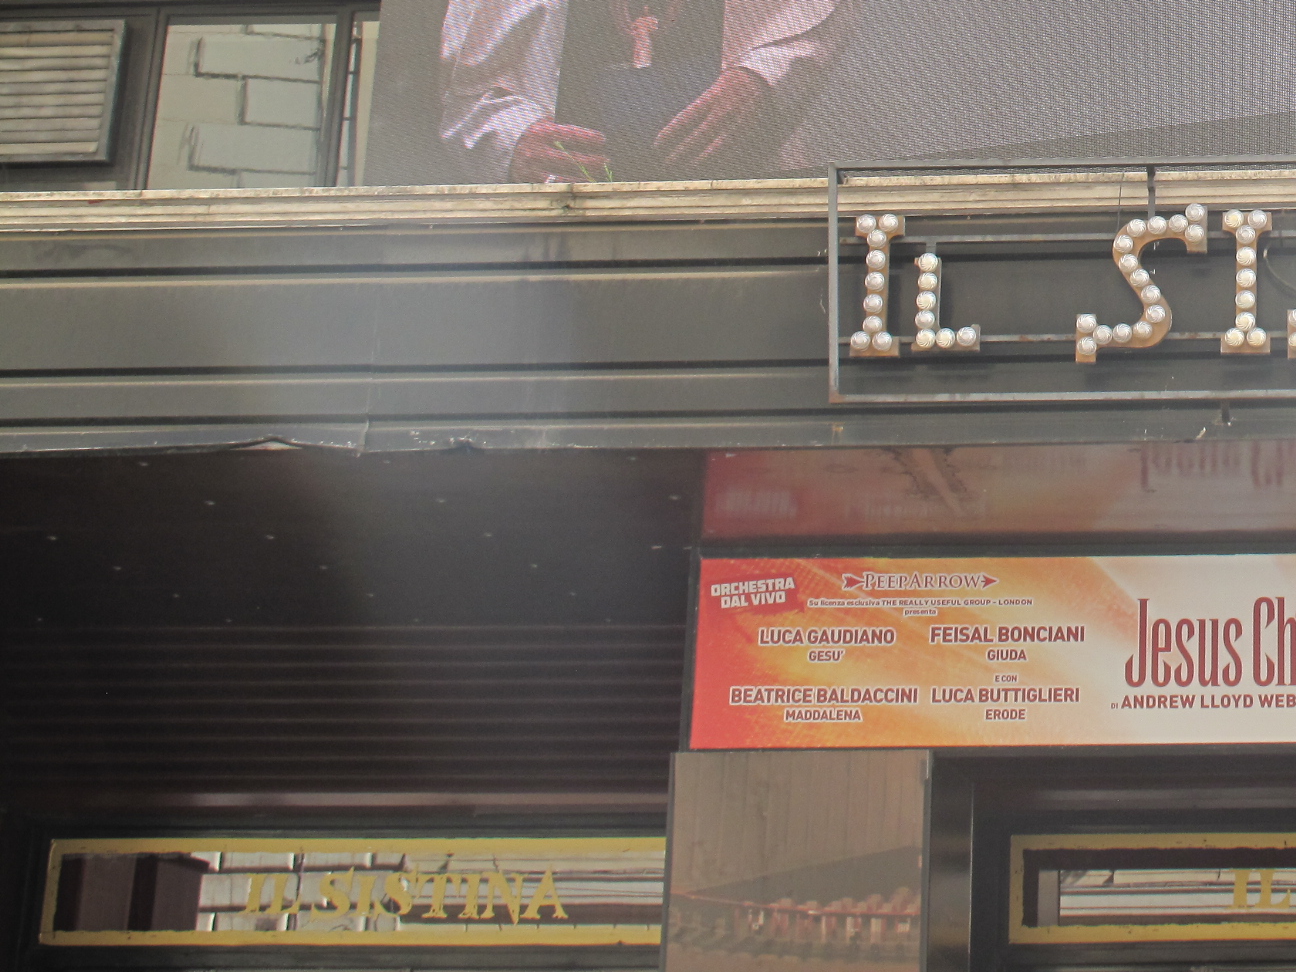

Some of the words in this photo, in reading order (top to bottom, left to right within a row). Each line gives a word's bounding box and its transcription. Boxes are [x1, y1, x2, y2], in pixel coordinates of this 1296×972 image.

[849, 212, 981, 356] IL
[711, 577, 795, 596] ORCHESTRA
[721, 595, 748, 608] DAL
[751, 591, 786, 605] VIVO
[759, 629, 804, 645] LUCA
[807, 629, 895, 645] GAUDIANO
[930, 626, 994, 644] FEISAL
[998, 626, 1085, 643] BONCIANI
[1125, 598, 1244, 687] Jesus
[987, 649, 1027, 662] GIUDA
[1000, 674, 1018, 683] CON
[730, 687, 813, 705] BEATRICE
[816, 687, 918, 705] BALDACCINI
[931, 687, 975, 704] LUCA
[978, 687, 1080, 703] BUTTIGLIERI
[1121, 695, 1196, 710] ANDREW
[1200, 694, 1254, 709] LLOYD
[785, 709, 861, 721] MADDALENA
[985, 708, 1026, 720] ERODE
[243, 873, 297, 915] IL
[309, 863, 569, 927] SISTINA
[1231, 868, 1290, 910] IL
